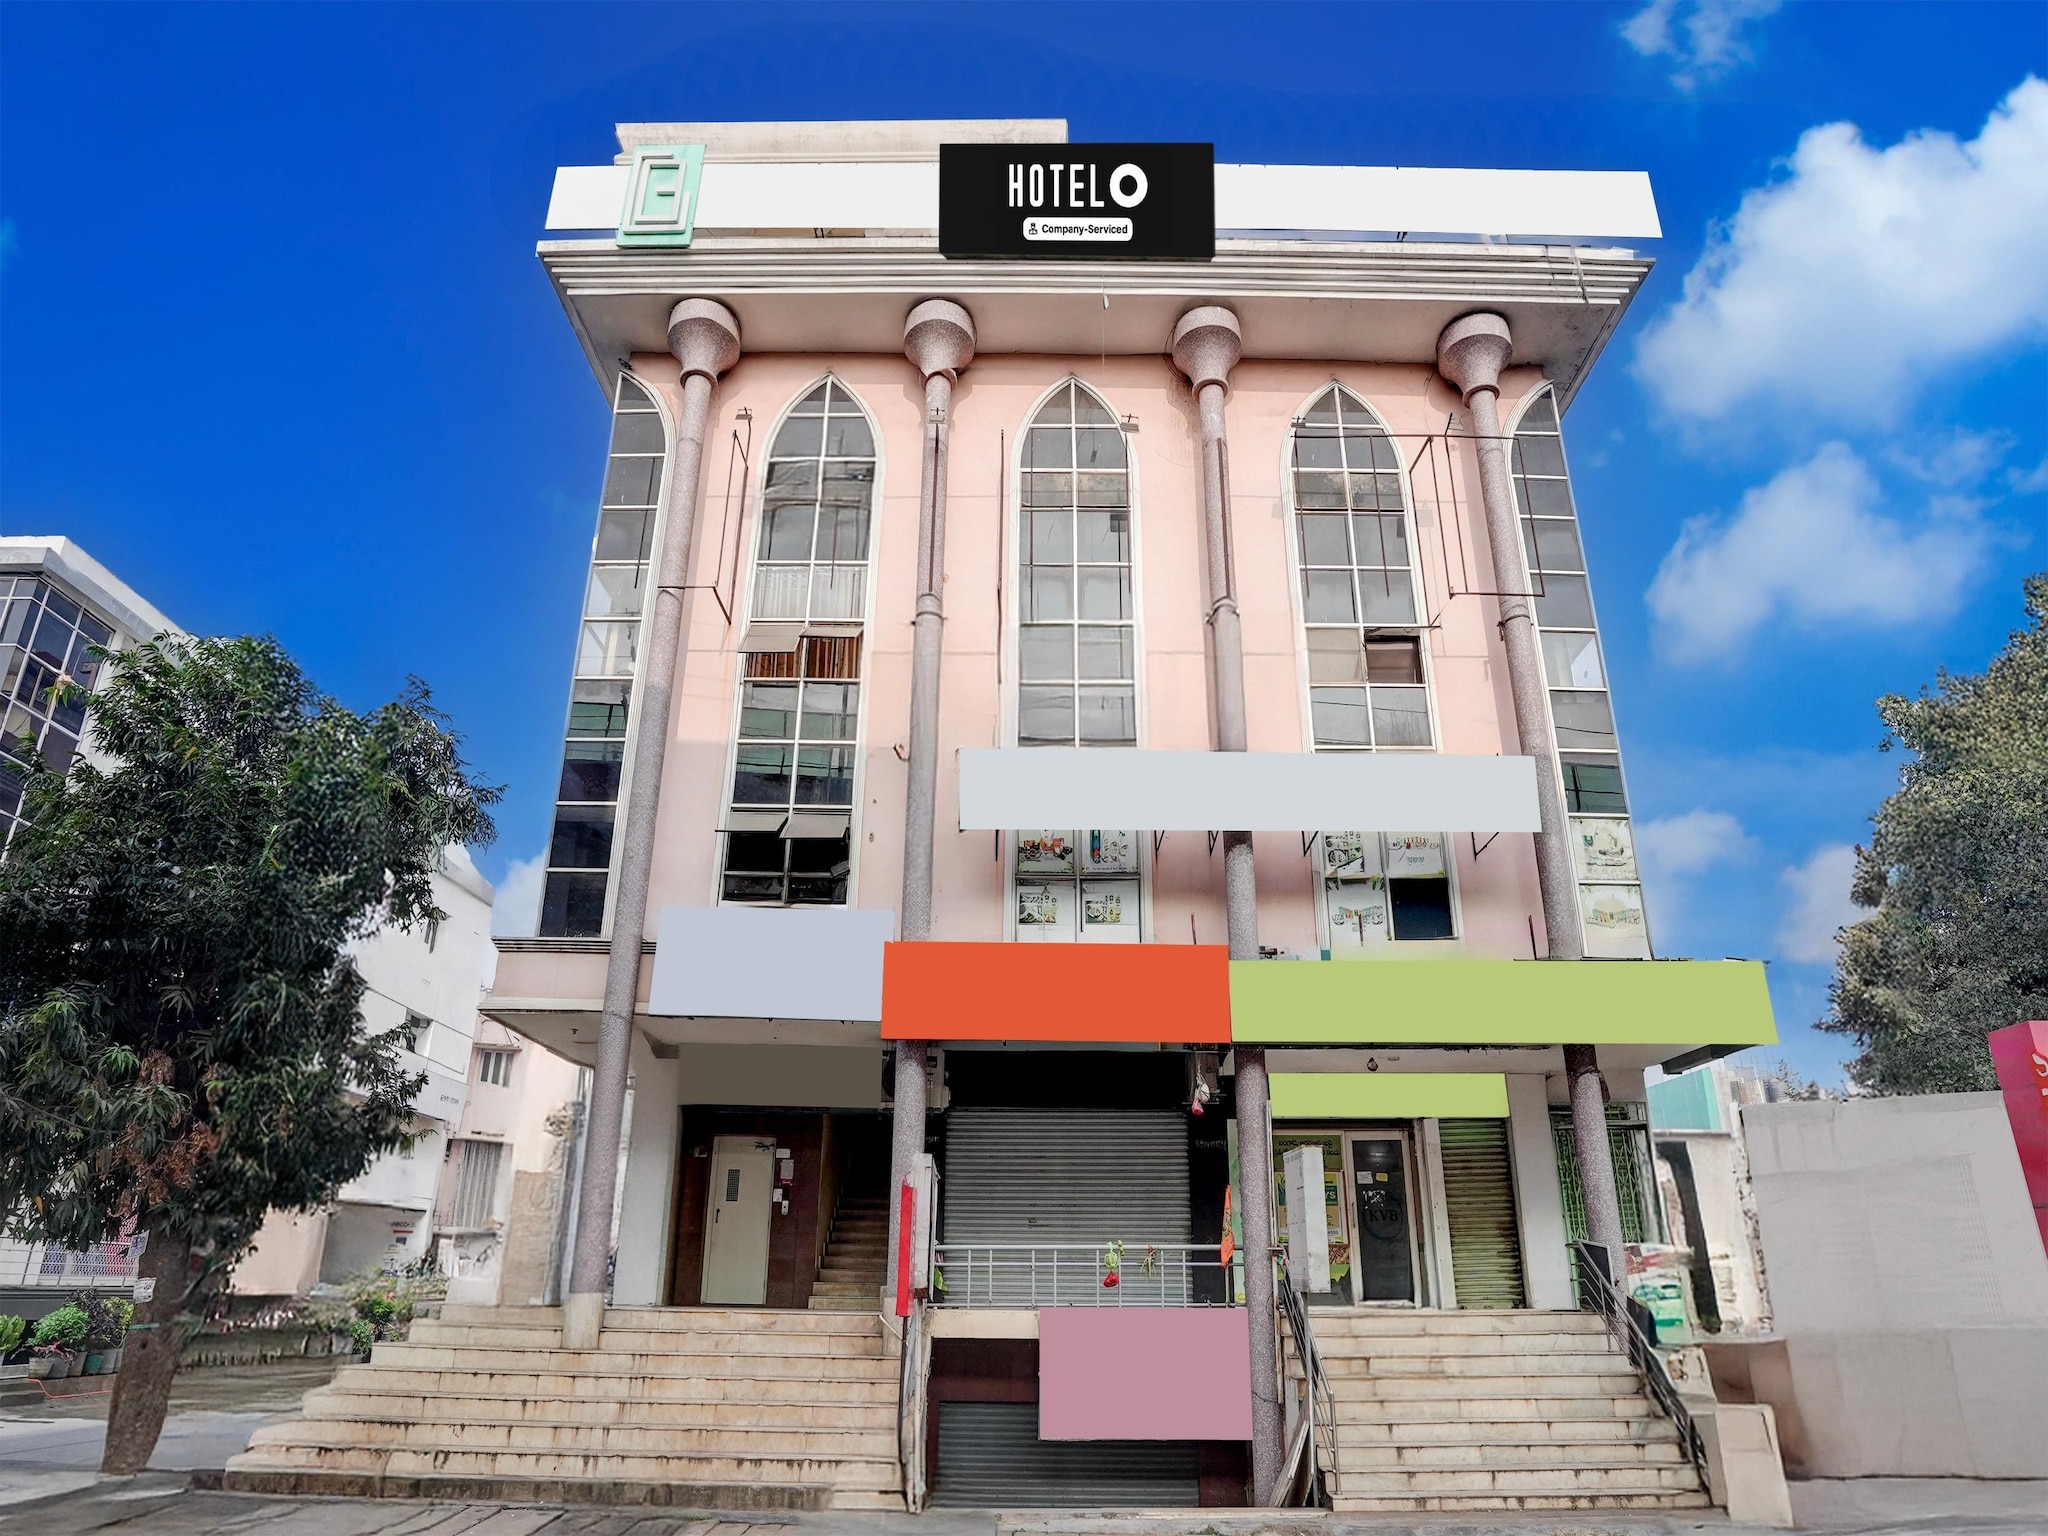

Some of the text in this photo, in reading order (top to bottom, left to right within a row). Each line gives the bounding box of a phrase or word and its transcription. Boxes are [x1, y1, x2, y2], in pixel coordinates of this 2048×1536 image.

[1008, 163, 1105, 208] HOTEL
[1041, 224, 1128, 236] Company-Serviced
[1368, 1209, 1399, 1222] KVB
